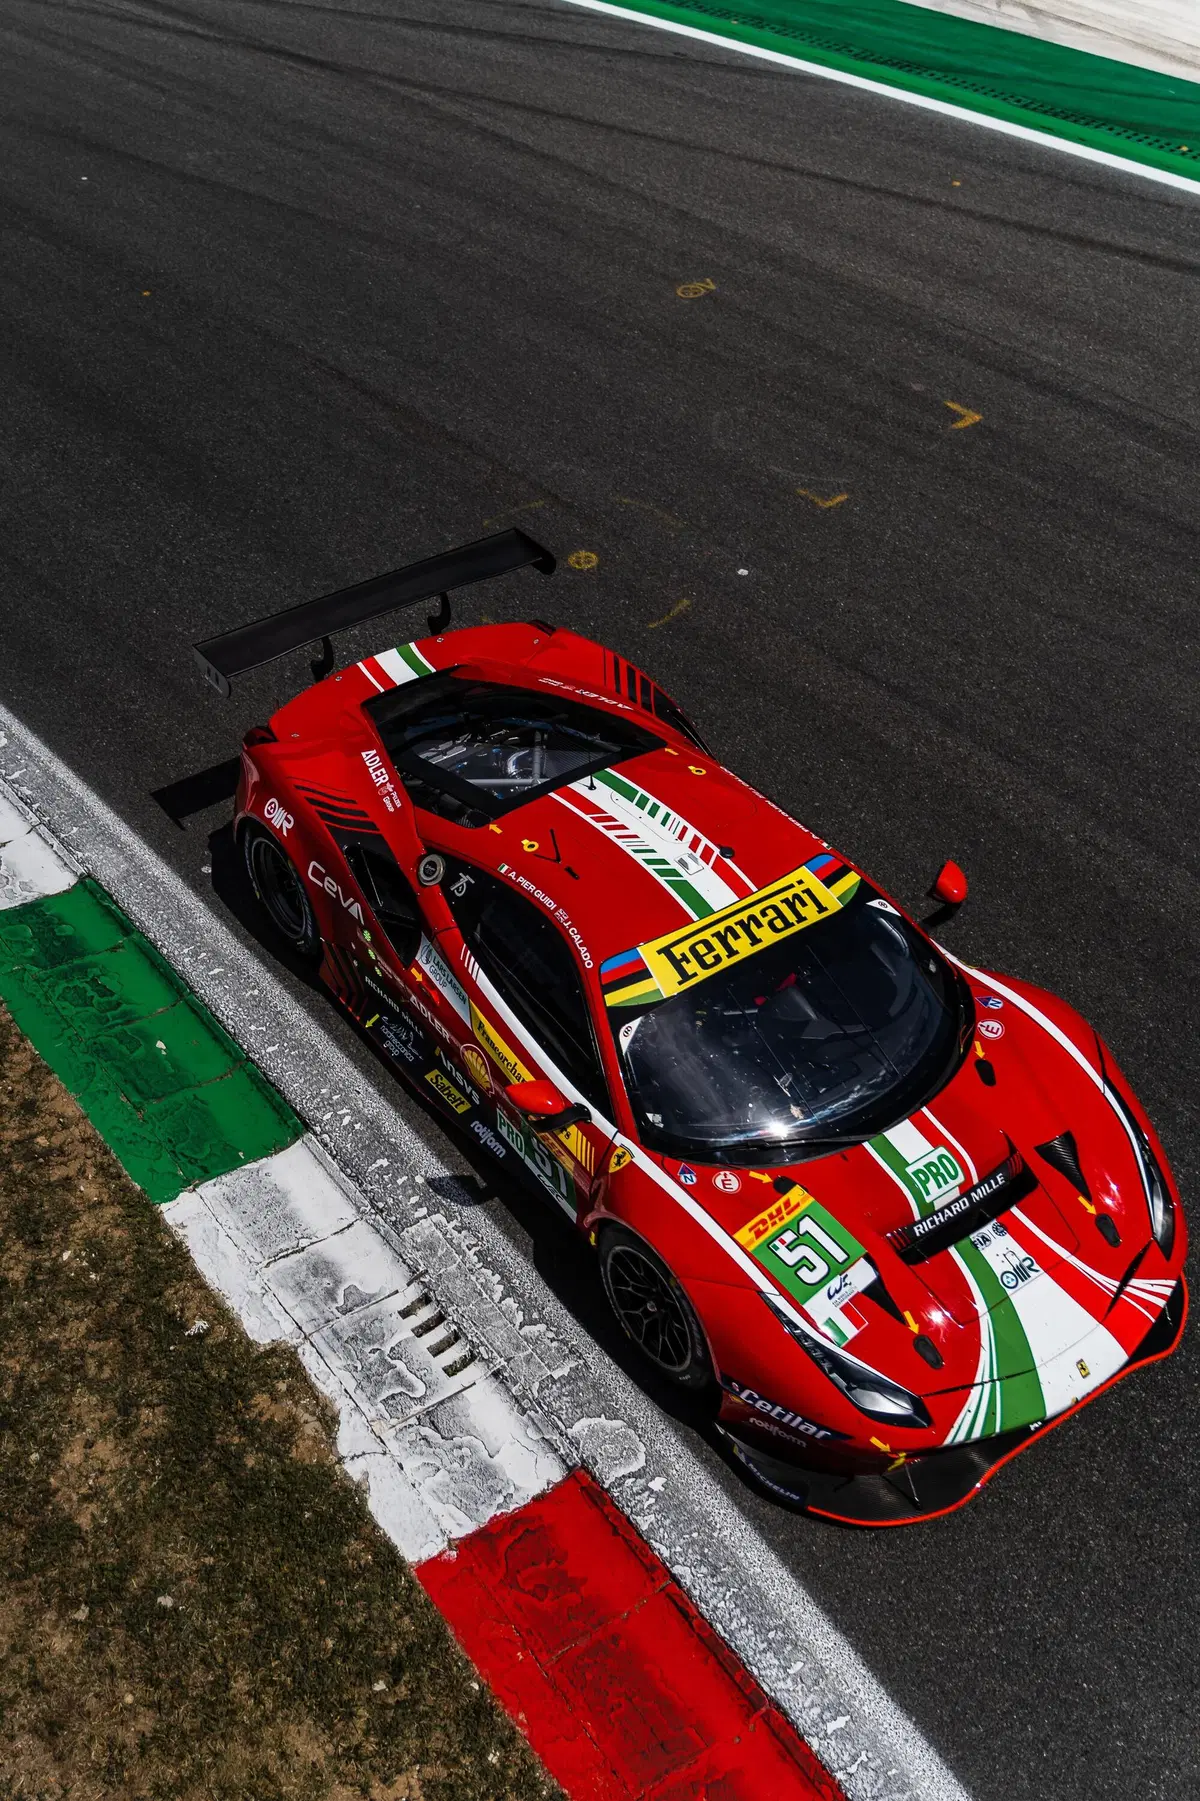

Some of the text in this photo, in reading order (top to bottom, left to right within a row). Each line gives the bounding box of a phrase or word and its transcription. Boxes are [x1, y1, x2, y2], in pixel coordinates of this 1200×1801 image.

[361, 749, 389, 787] ADLER
[507, 871, 557, 911] A. PIER GUIDI
[562, 920, 594, 969] J. CALADO
[656, 878, 829, 986] Ferrari
[428, 965, 448, 988] GROUP
[432, 955, 469, 1005] LARS LARSEN
[365, 975, 400, 1013] RICHARD
[401, 1011, 424, 1040] MILLE
[410, 994, 451, 1044] ADLER
[383, 1040, 401, 1058] group
[430, 1073, 465, 1110] Sabelt
[469, 1120, 507, 1158] rotiform
[497, 1112, 524, 1155] PRO
[531, 1136, 568, 1198] 51
[911, 1153, 959, 1197] PRO
[748, 1197, 801, 1241] DHL
[913, 1172, 1006, 1237] RICHARD MILLE
[767, 1214, 850, 1286] 51
[972, 1233, 992, 1251] FIA
[740, 1388, 832, 1439] Cetilar
[749, 1416, 807, 1449] rotiform
[748, 1463, 800, 1501] MICHELIN
